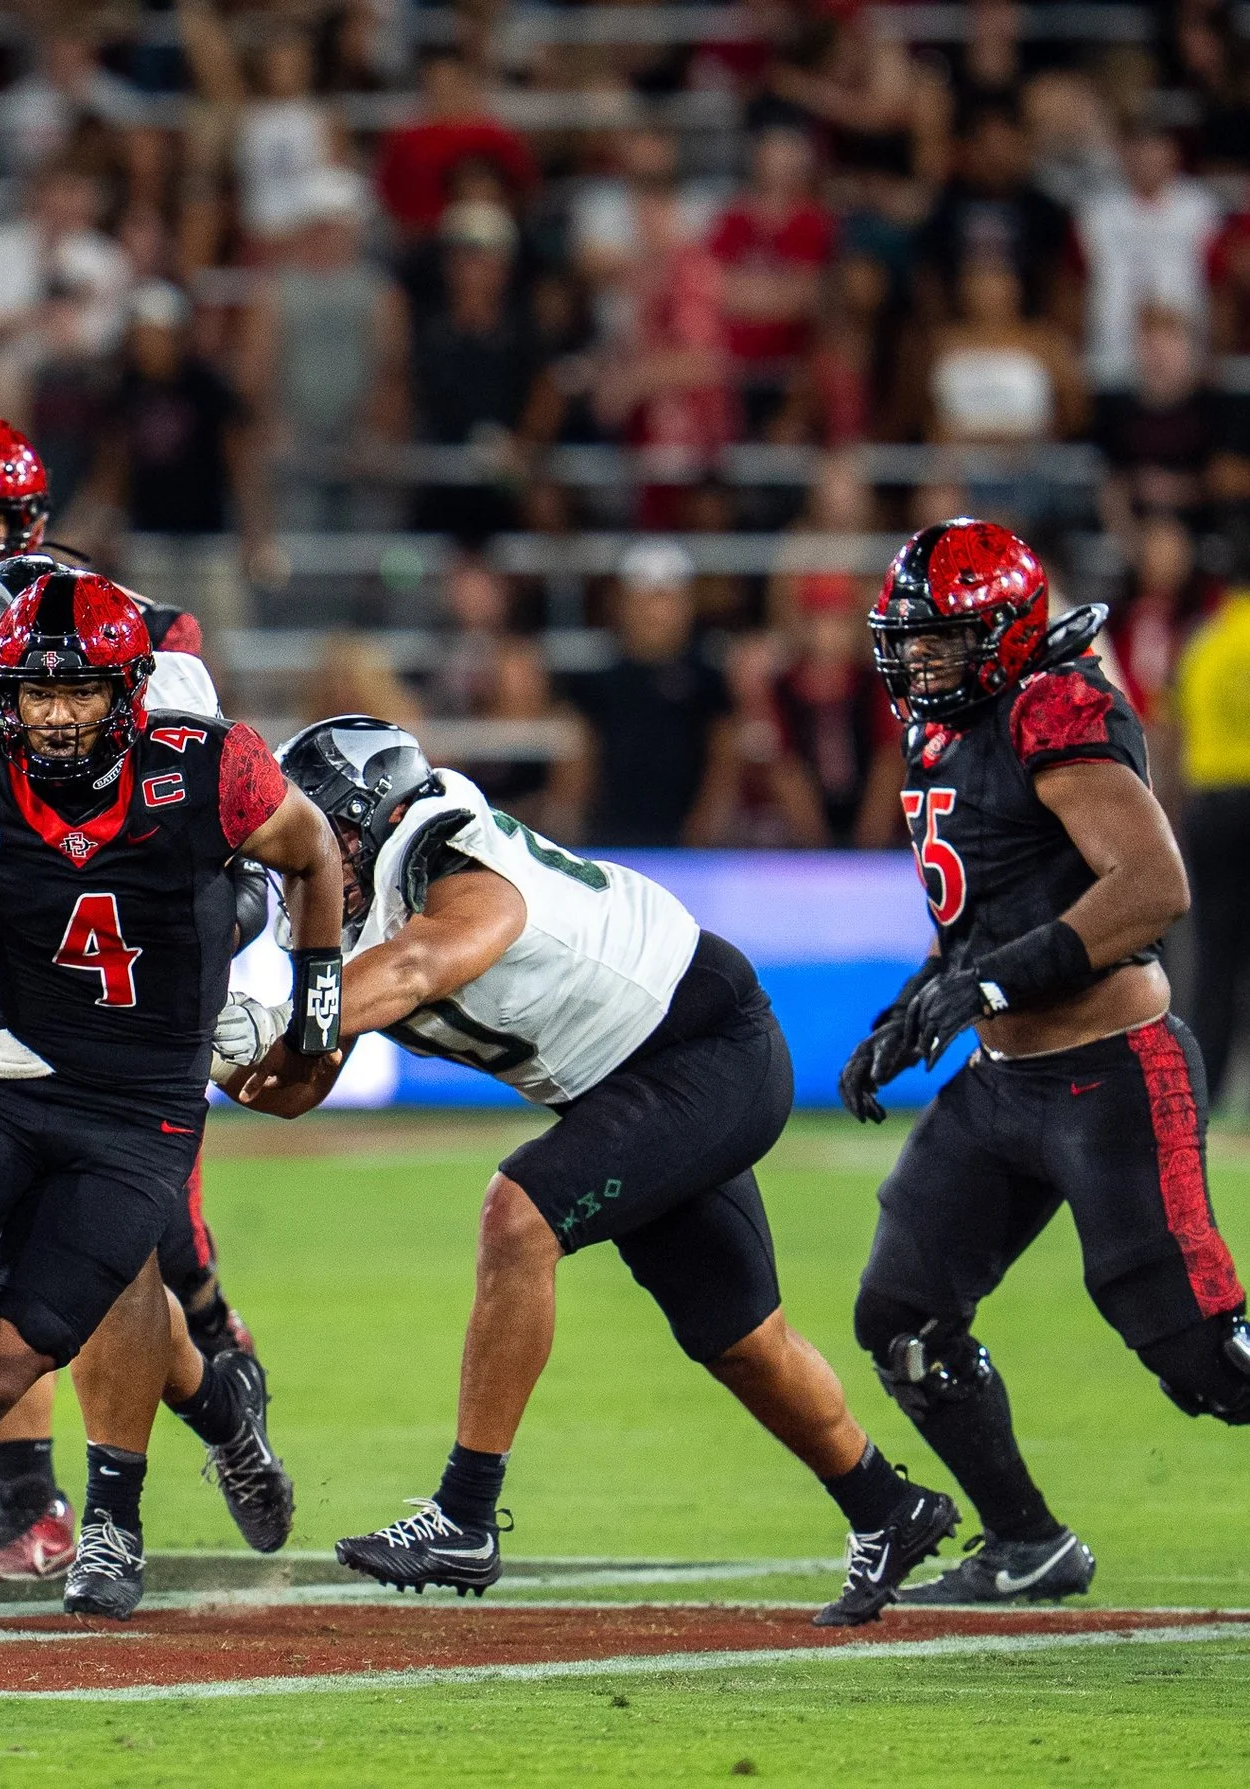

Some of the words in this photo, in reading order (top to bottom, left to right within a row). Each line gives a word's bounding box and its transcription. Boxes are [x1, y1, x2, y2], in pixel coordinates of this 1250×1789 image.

[151, 726, 207, 752] 4
[142, 773, 186, 807] C
[53, 892, 142, 1008] 4
